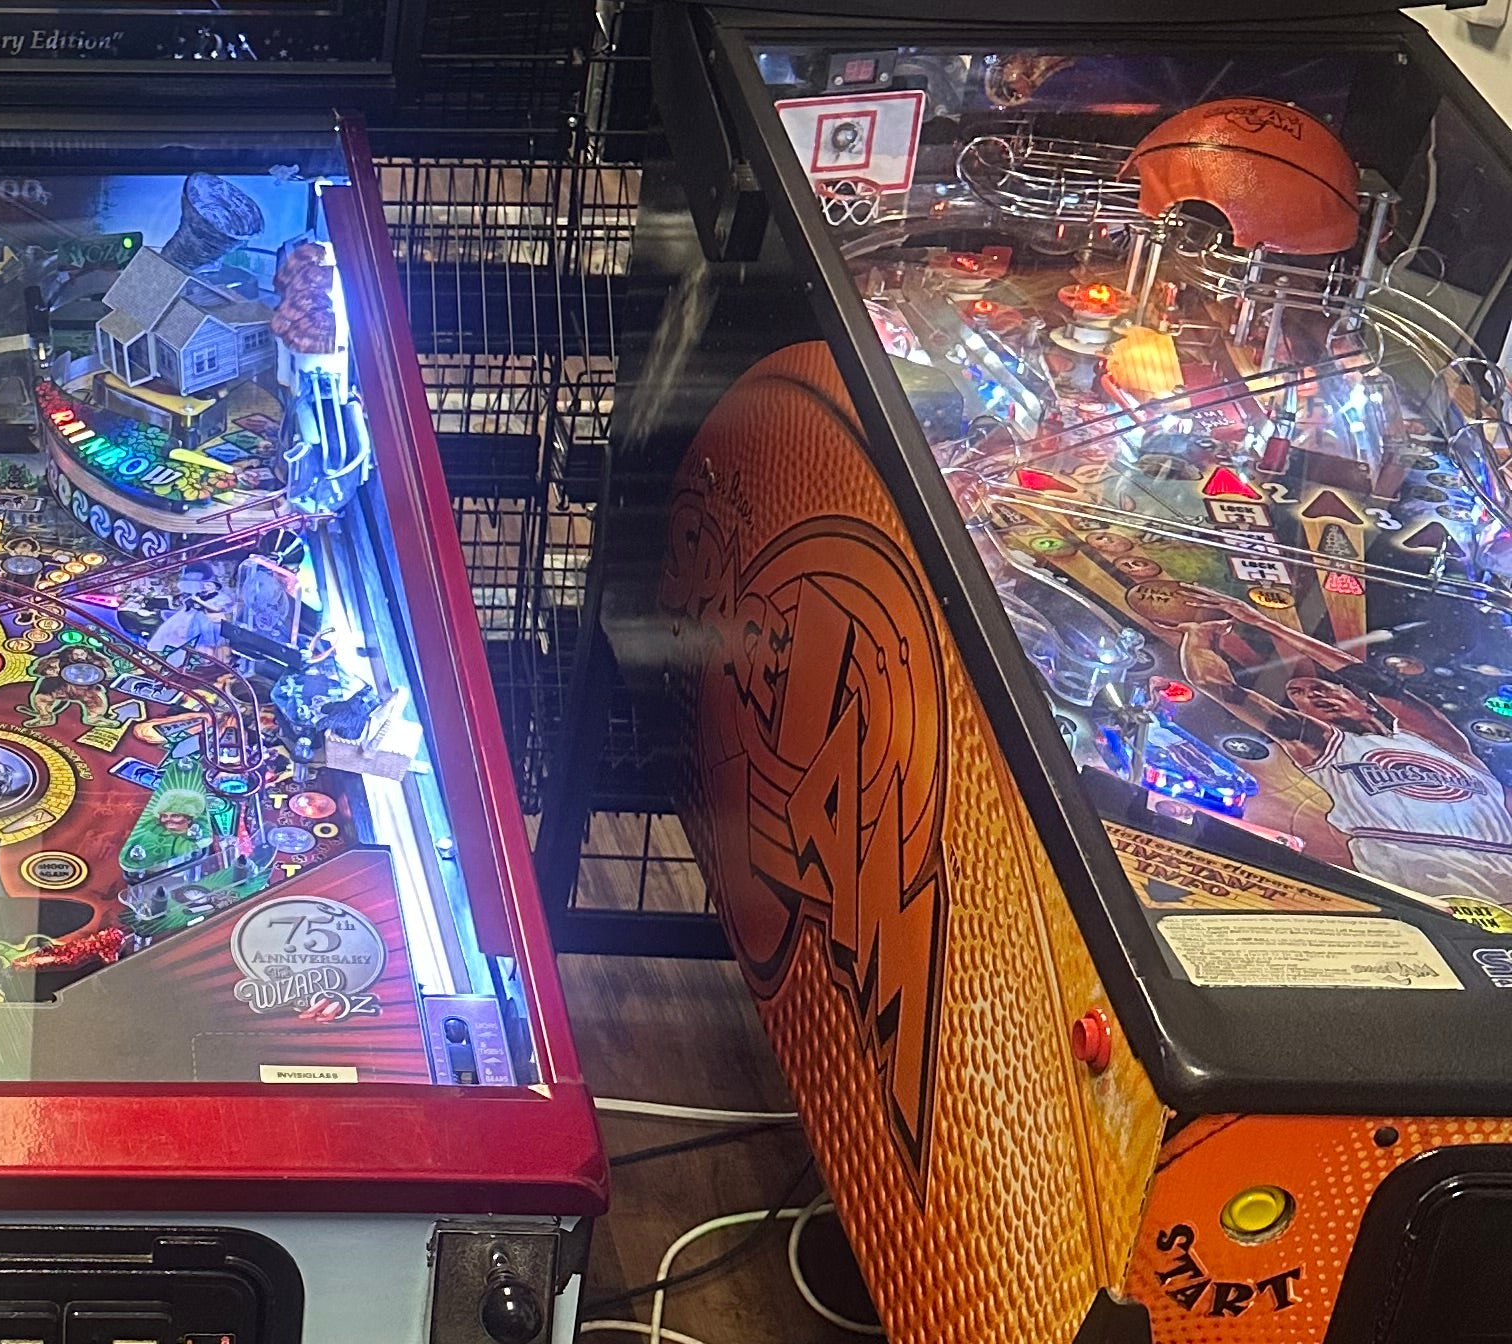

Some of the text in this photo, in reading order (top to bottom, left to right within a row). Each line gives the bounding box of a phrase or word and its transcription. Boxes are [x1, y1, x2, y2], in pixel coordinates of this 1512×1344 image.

[50, 408, 184, 486] RAINBOW
[267, 914, 356, 954] 75th
[251, 949, 372, 965] ANNIVERSARY
[240, 967, 341, 1009] WIZARD
[276, 1071, 339, 1080] INVISIGLASS
[1154, 1222, 1304, 1319] START
